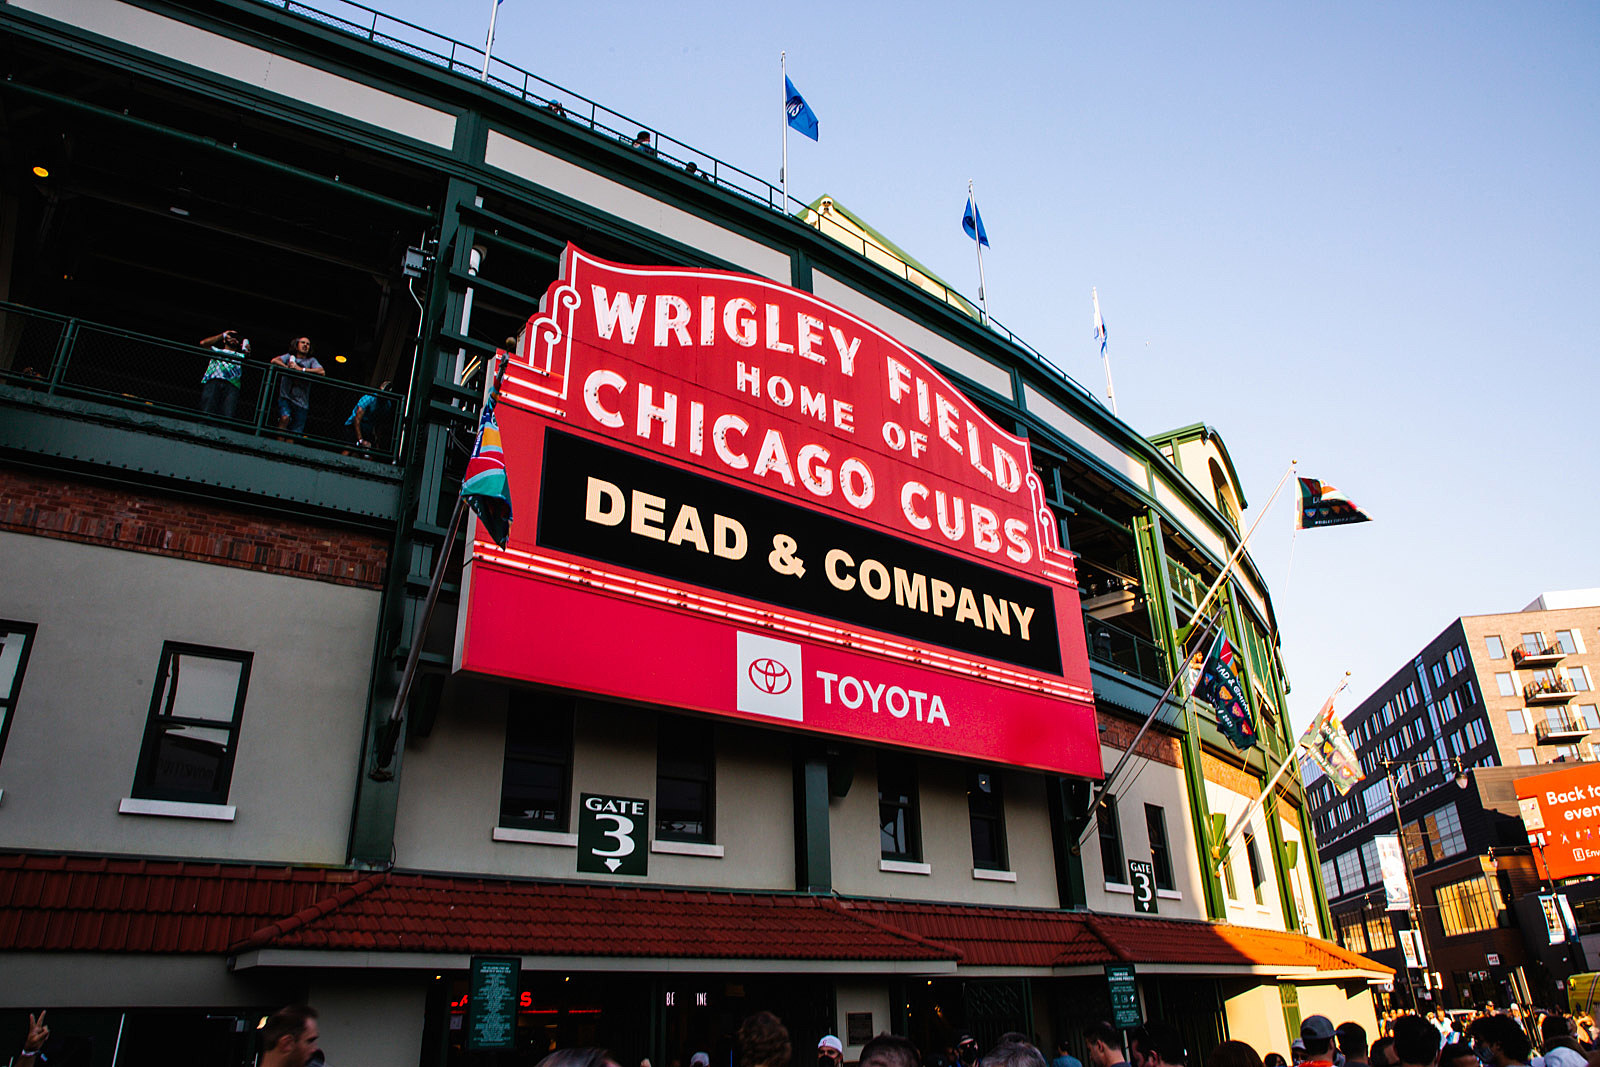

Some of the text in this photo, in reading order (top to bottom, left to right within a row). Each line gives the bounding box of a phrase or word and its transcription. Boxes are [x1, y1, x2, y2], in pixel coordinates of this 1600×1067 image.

[591, 284, 1023, 493] WRIGLEY FIELD
[736, 361, 928, 459] HOME OF
[583, 369, 1034, 564] CHICAGO CUBS
[585, 476, 1035, 641] DEAD & COMPANY
[816, 670, 951, 727] TOYOTA
[585, 797, 645, 816] GATE
[1546, 786, 1586, 805] Back
[591, 813, 636, 857] 3
[1130, 861, 1151, 874] GATE
[1135, 872, 1152, 902] 3
